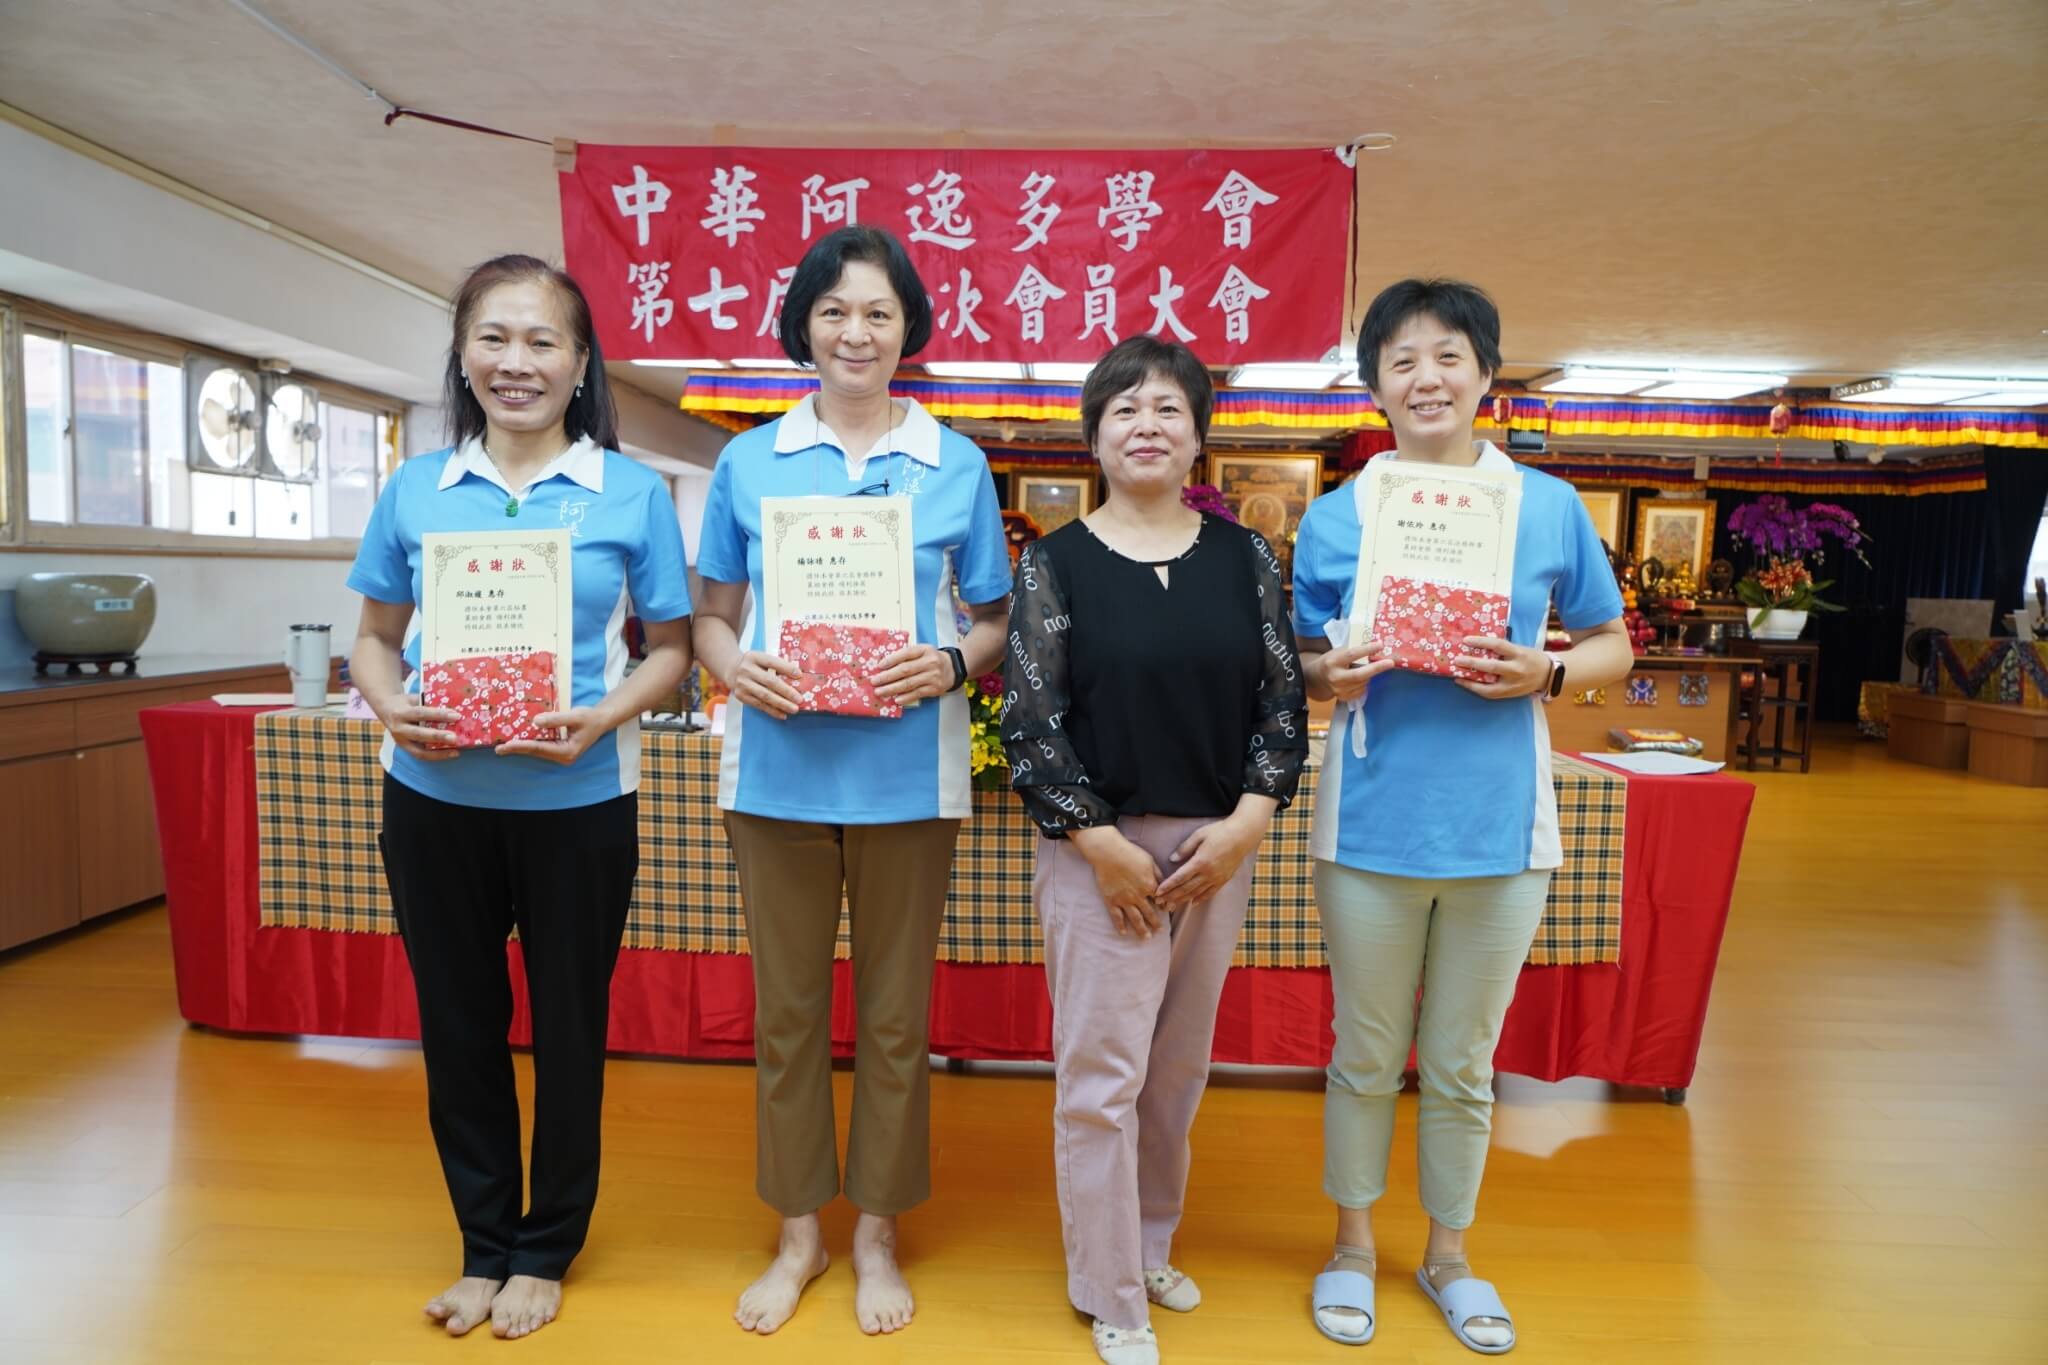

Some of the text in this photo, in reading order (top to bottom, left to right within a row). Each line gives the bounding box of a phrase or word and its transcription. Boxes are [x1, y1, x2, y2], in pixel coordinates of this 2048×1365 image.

[611, 166, 1279, 252] 中華阿逸多學會
[628, 261, 1270, 344] 第七次會員大會
[1411, 490, 1472, 508] 感謝狀
[807, 525, 868, 540] 感謝狀
[467, 559, 527, 574] 感謝狀
